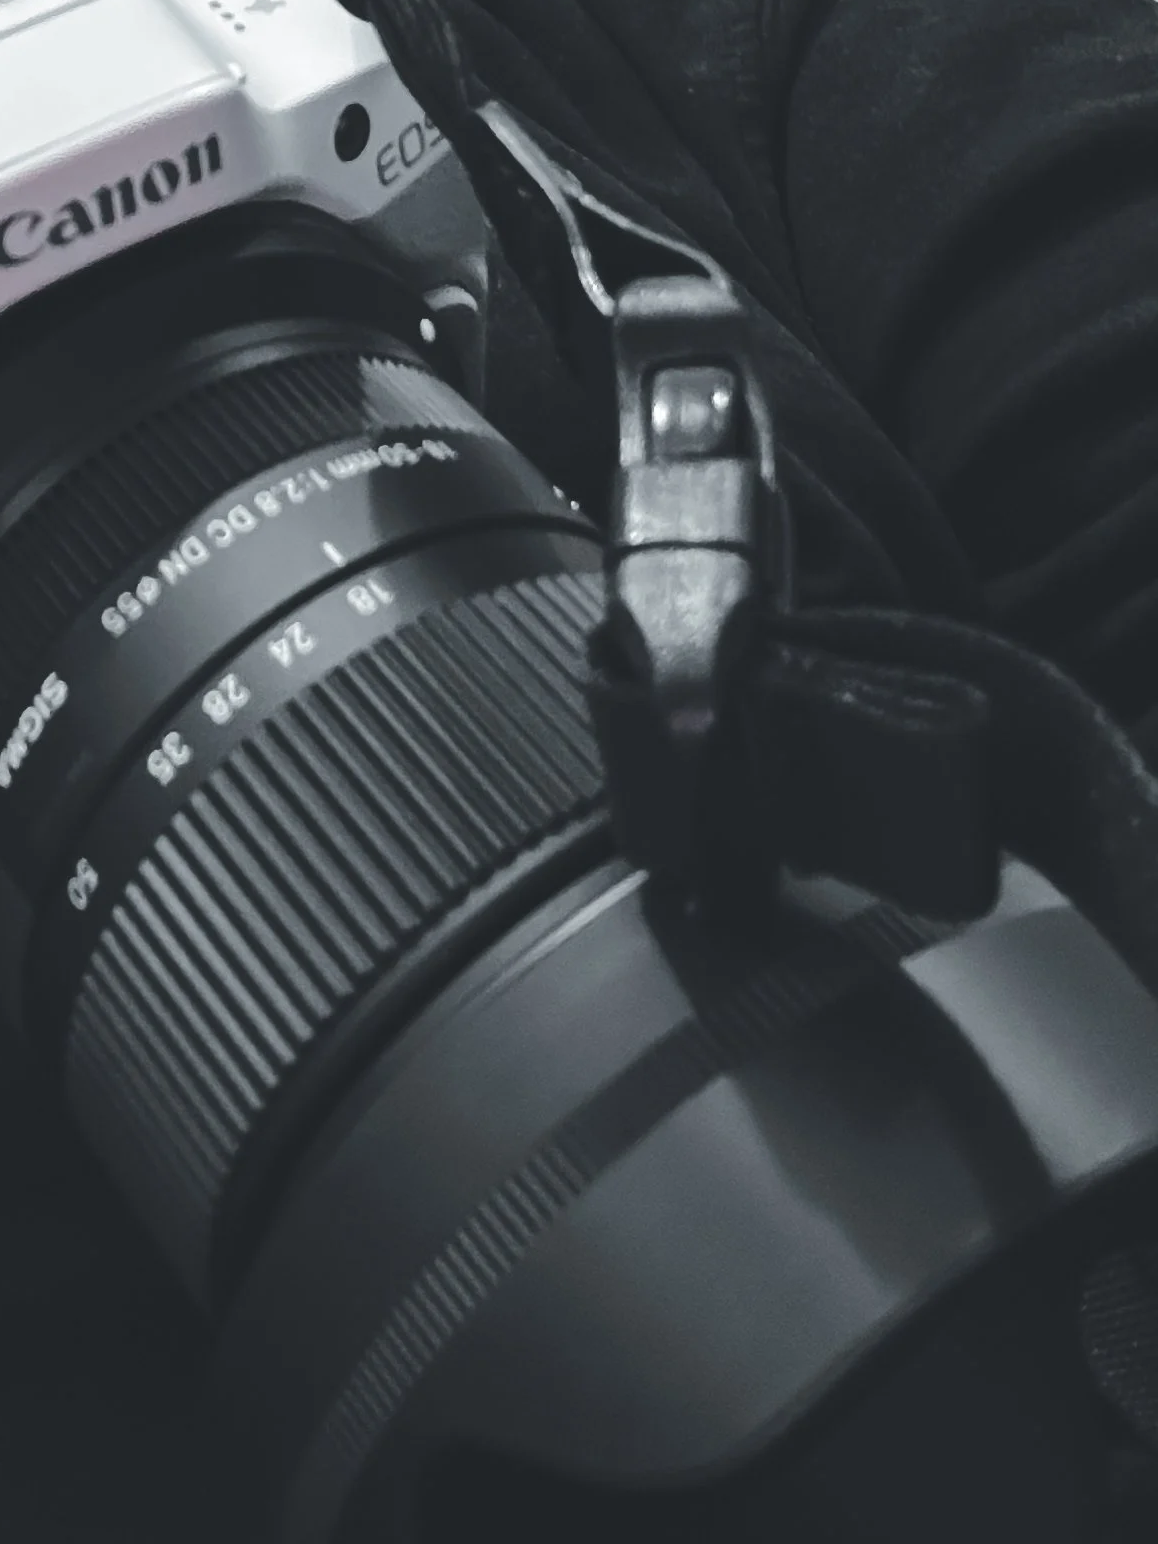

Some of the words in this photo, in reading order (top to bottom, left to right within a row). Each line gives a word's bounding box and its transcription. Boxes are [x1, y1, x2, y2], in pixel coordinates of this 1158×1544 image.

[253, 467, 331, 517] 1:2.8
[206, 502, 260, 548] DC
[158, 535, 210, 585] DN
[345, 578, 396, 617] 18
[267, 621, 319, 670] 24
[201, 672, 252, 725] 28
[146, 731, 194, 787] 35
[67, 857, 99, 911] 50
